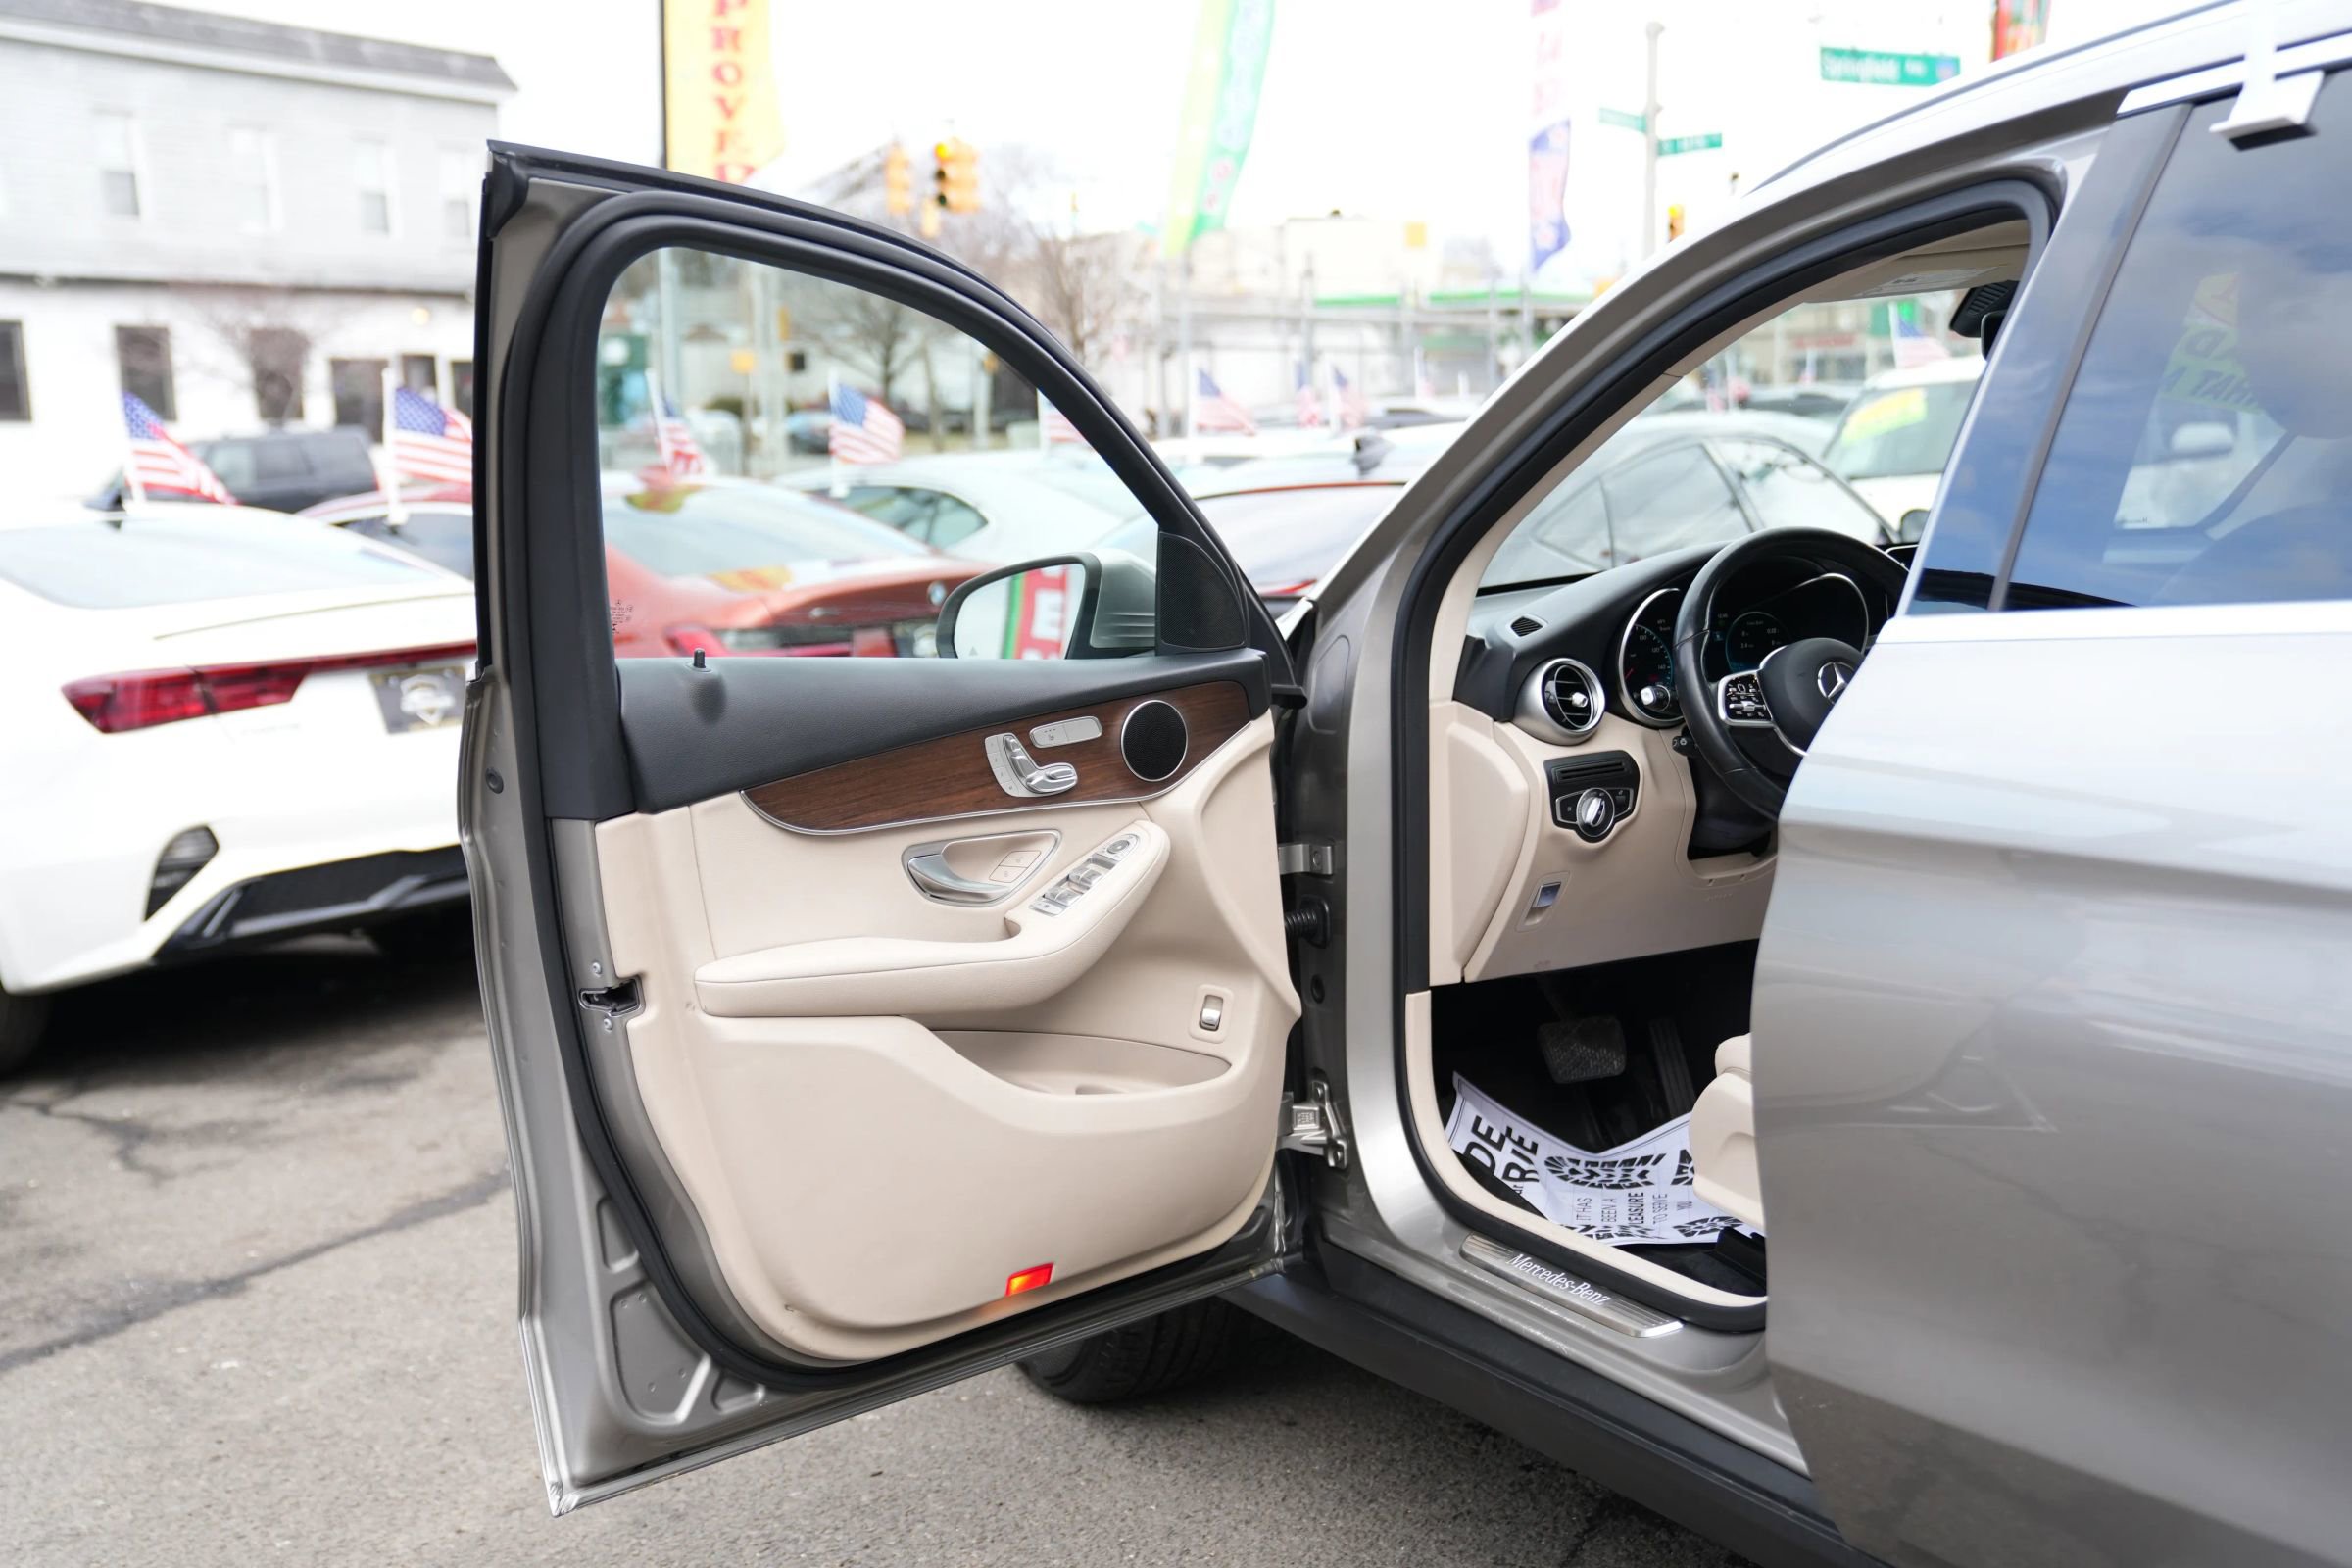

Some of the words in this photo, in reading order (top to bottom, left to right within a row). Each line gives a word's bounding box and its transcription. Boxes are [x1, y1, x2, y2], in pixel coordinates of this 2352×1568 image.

[1576, 1198, 1592, 1213] HAS
[1601, 1205, 1617, 1222] BEEN
[1628, 1192, 1644, 1225] LEASURE
[1652, 1194, 1668, 1214] SERVE
[1505, 1253, 1612, 1306] Mercedes-Benz
